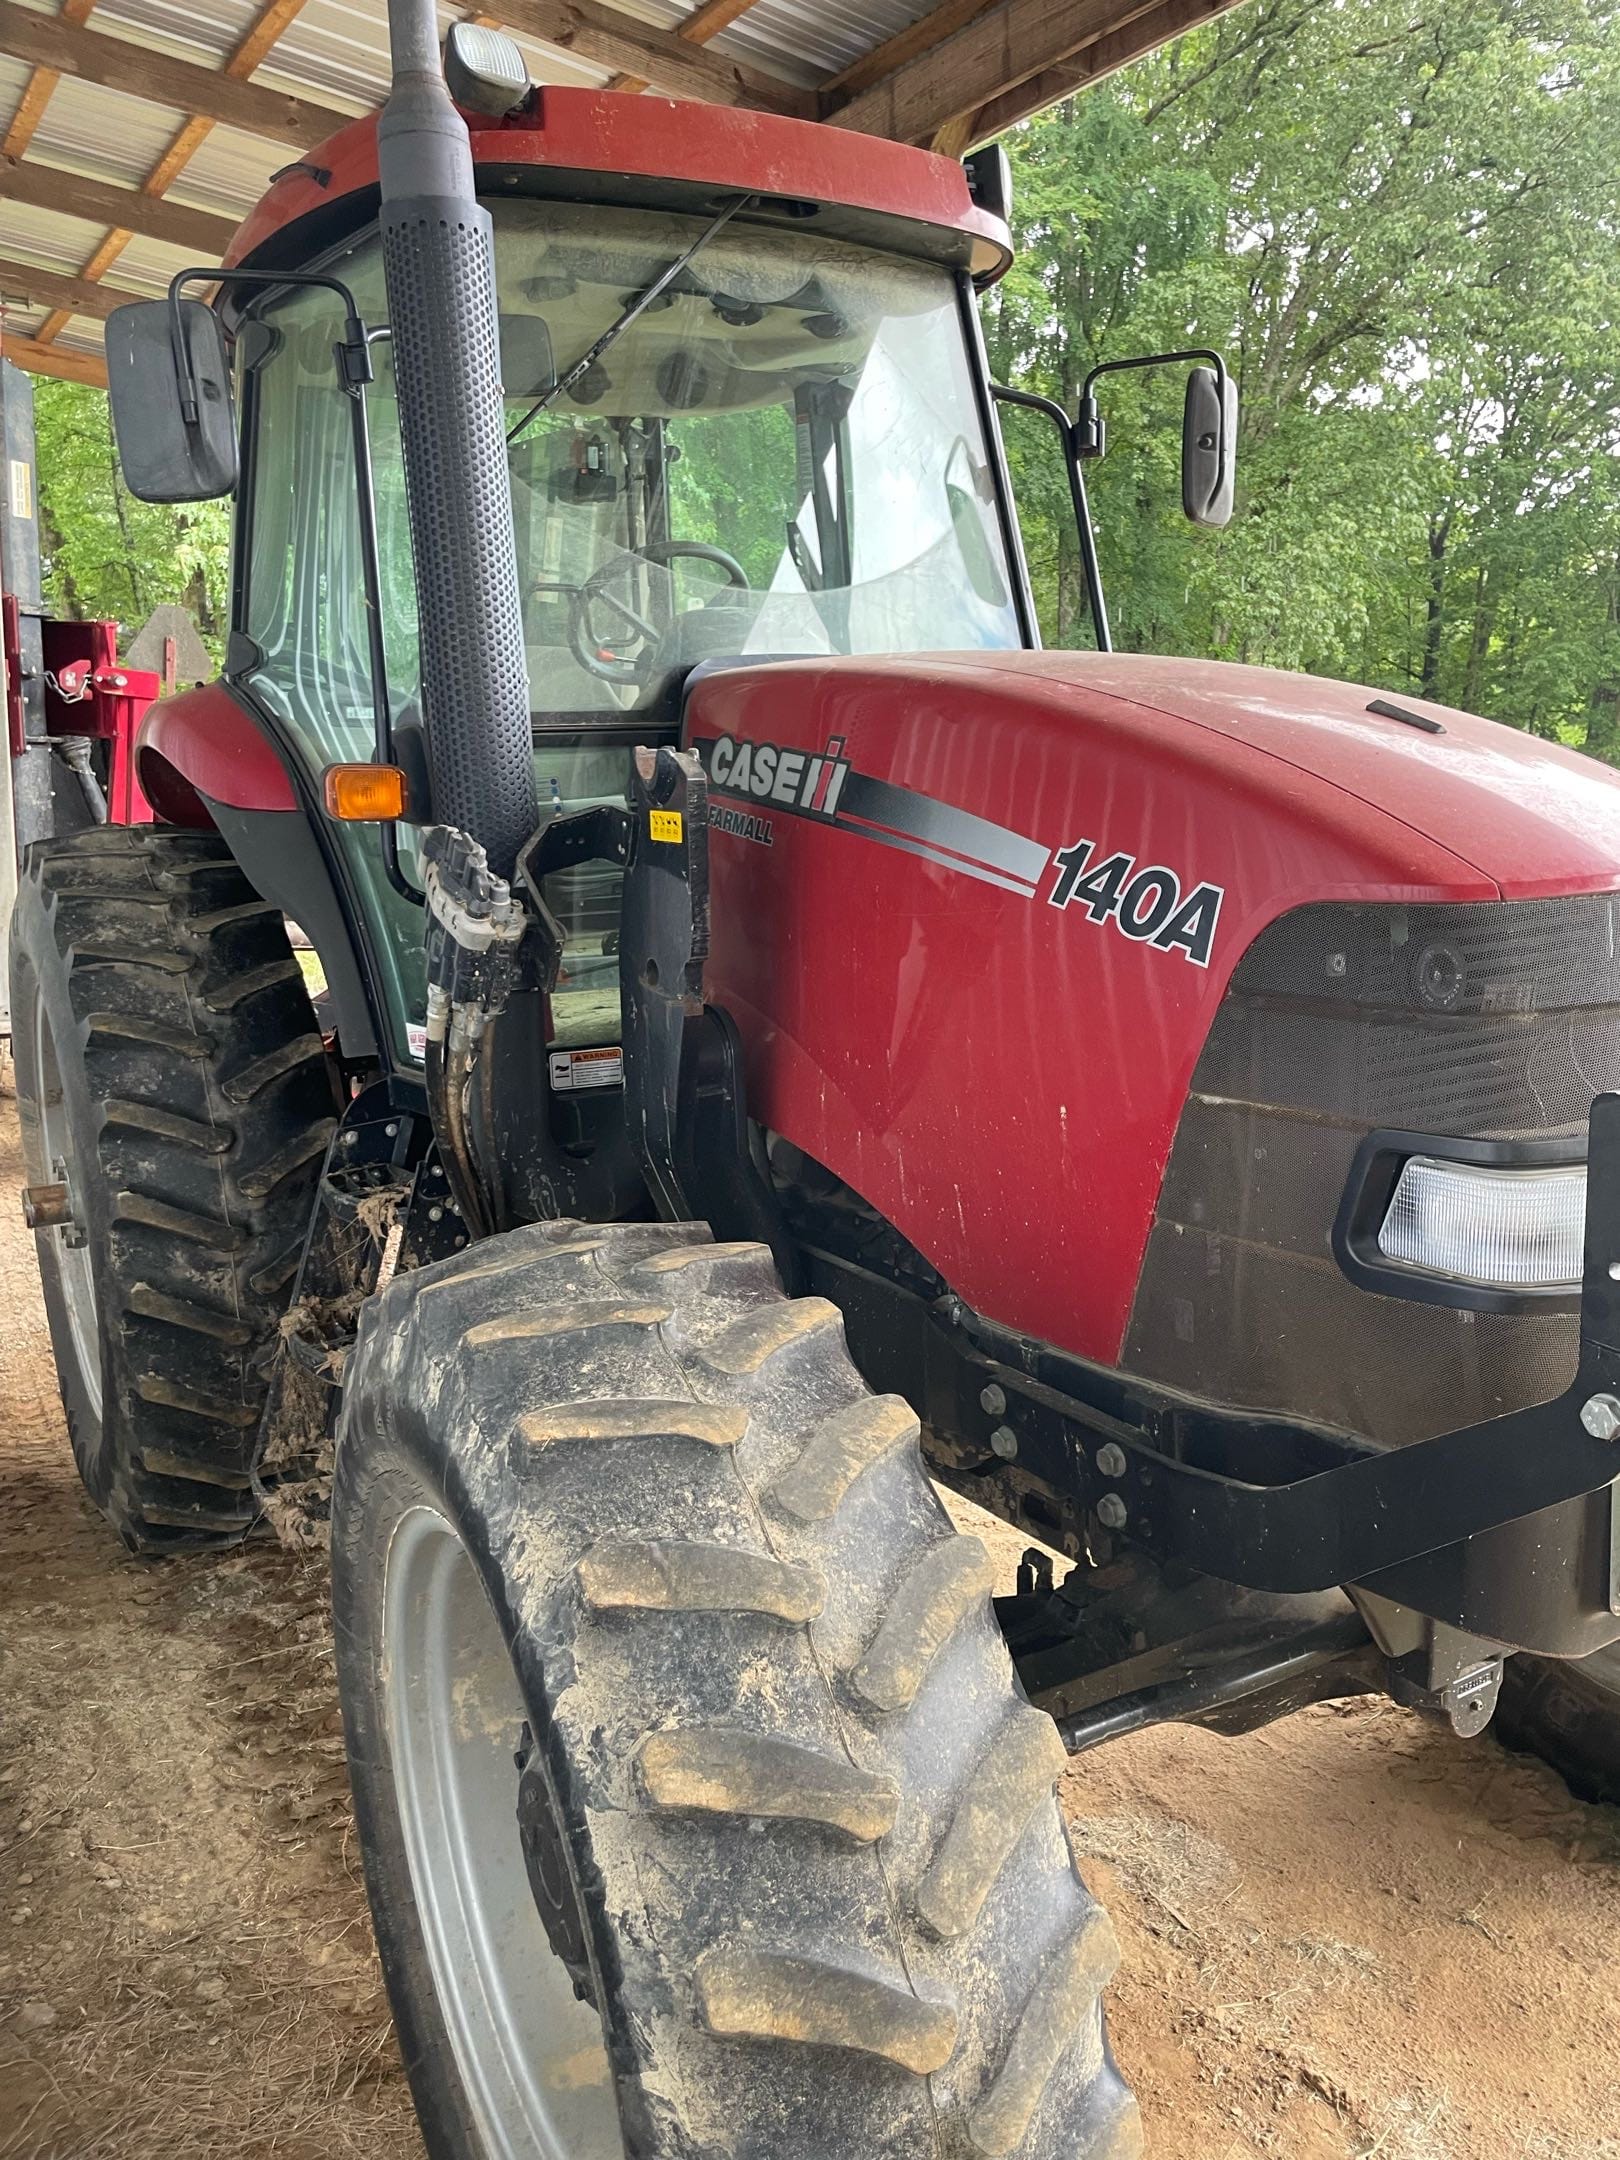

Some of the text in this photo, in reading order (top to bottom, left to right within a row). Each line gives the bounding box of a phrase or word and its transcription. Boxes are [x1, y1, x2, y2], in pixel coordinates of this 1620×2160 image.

[710, 736, 806, 804] CASE
[707, 804, 774, 847] FARMALL
[1048, 838, 1225, 969] 140A
[583, 1050, 619, 1060] WARNING
